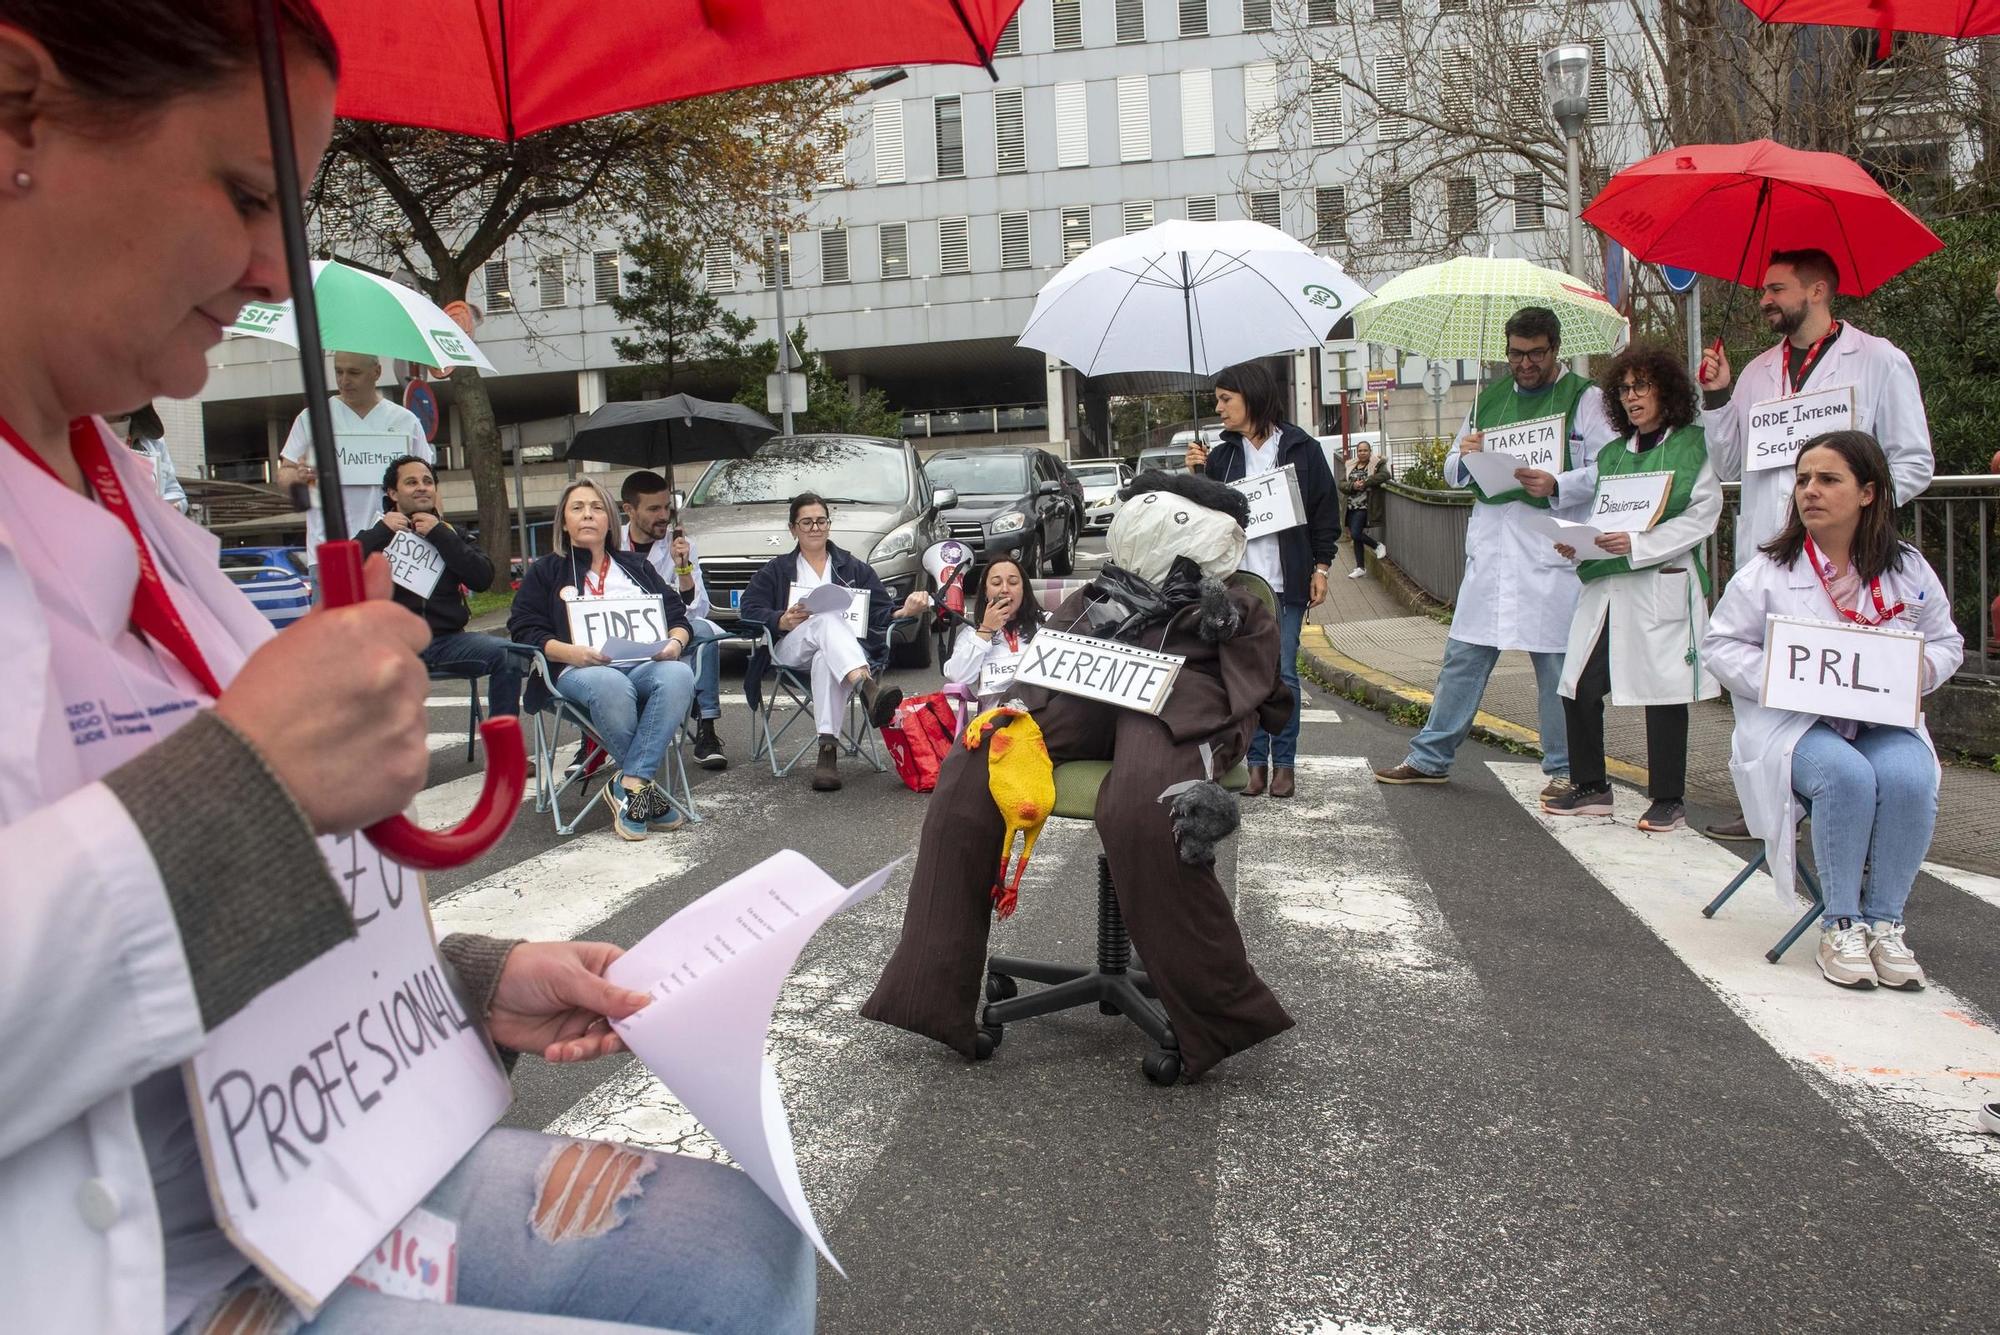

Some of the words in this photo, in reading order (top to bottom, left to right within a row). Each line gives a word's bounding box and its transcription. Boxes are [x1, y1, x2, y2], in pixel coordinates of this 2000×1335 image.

[1752, 411, 1789, 429] ORDE
[1488, 426, 1555, 451] TARXETA
[1787, 427, 1794, 436] E
[1516, 448, 1553, 466] ARIA
[1260, 478, 1277, 497] T.
[1024, 645, 1170, 703] XERENTE
